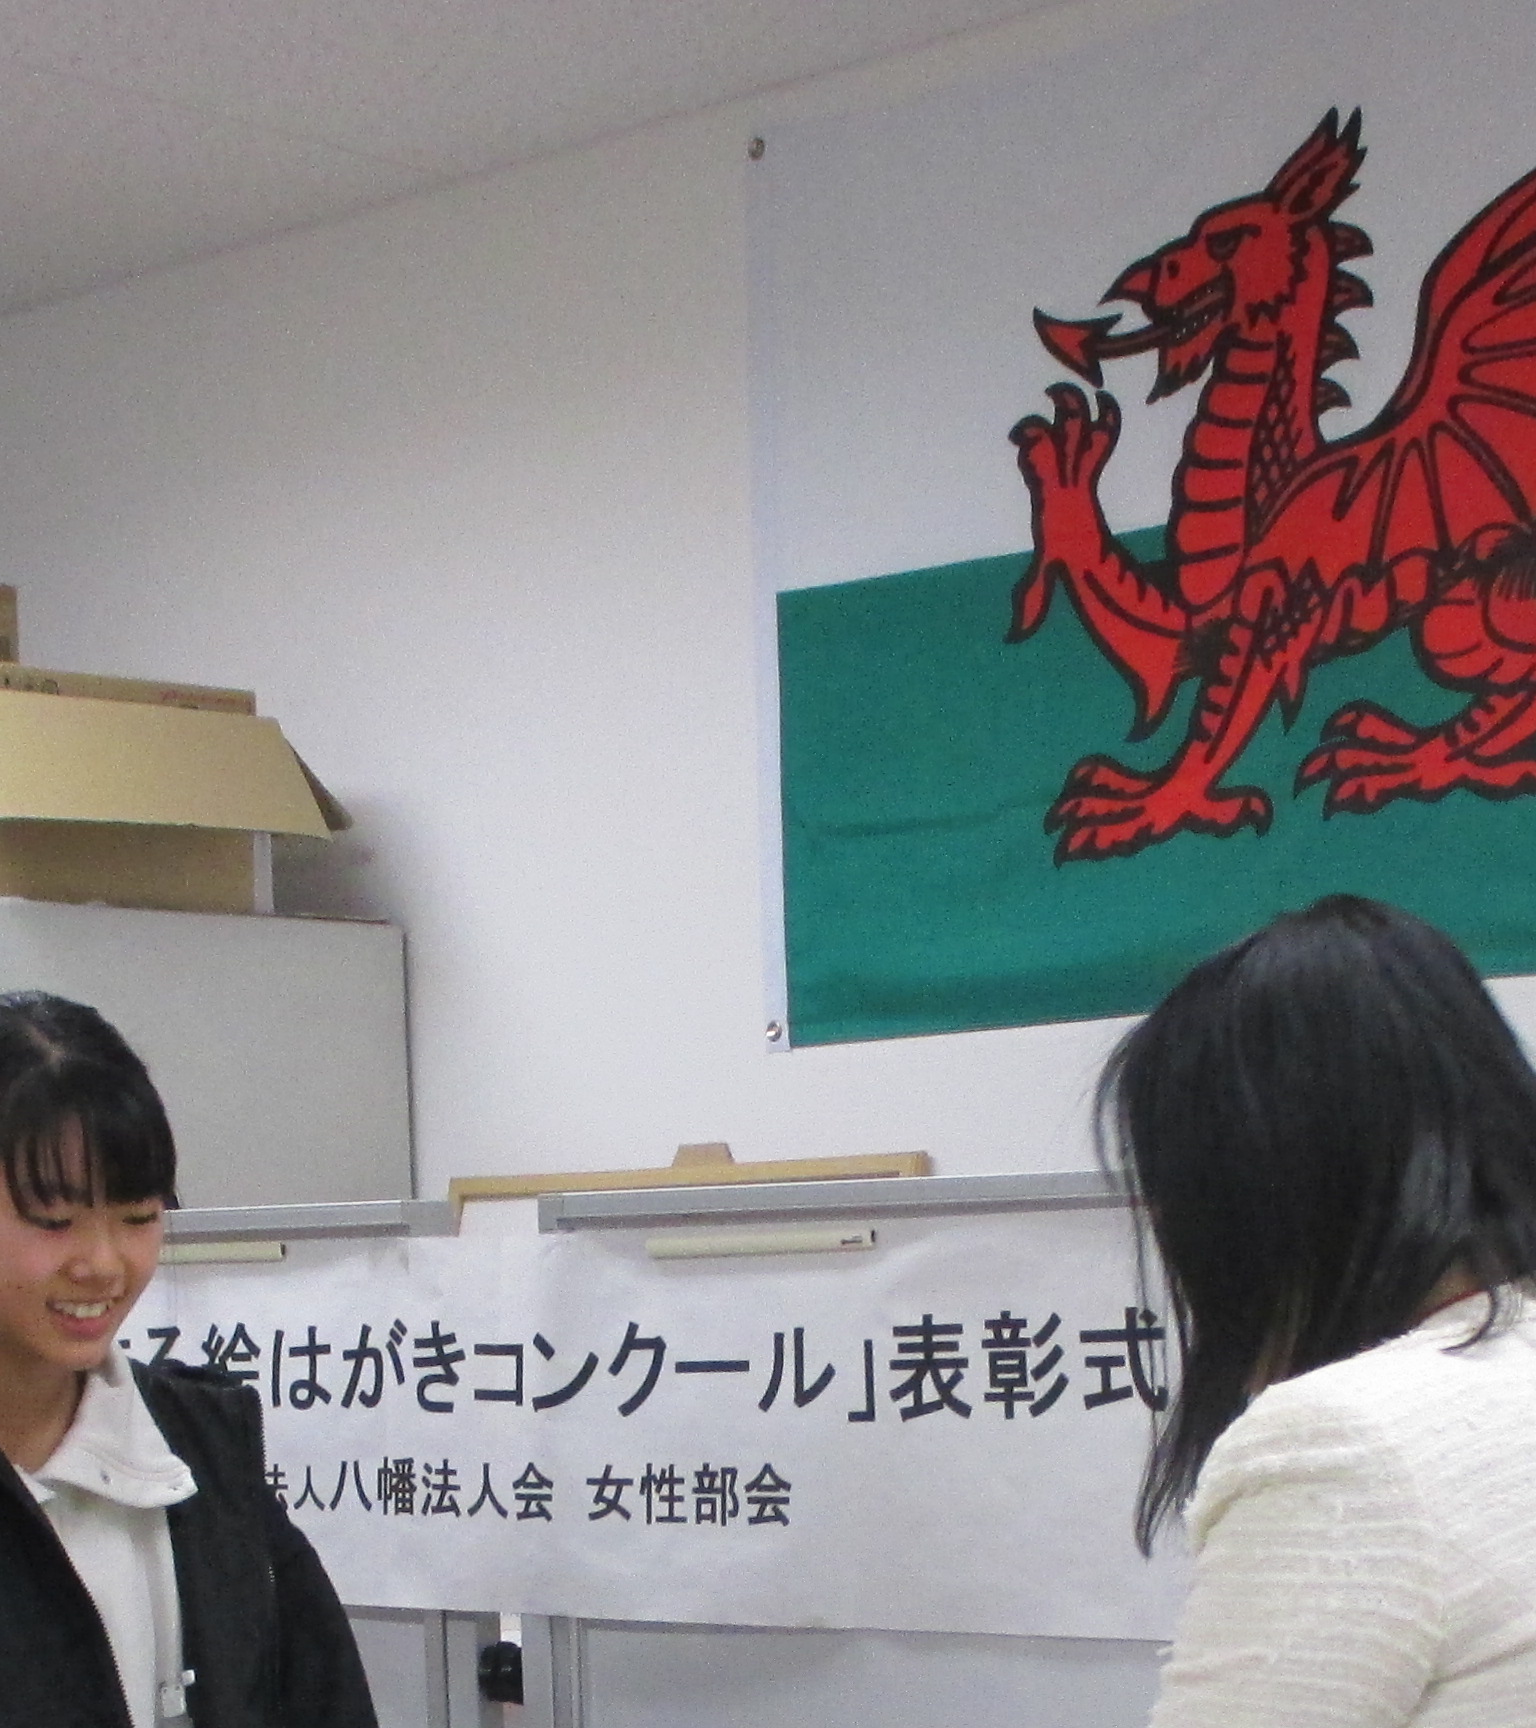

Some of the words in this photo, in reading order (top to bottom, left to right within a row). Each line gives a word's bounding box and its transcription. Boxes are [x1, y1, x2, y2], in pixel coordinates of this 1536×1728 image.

[117, 1306, 1168, 1422] 絵はがきコンクール」表彰式
[585, 1462, 793, 1528] 女性部会
